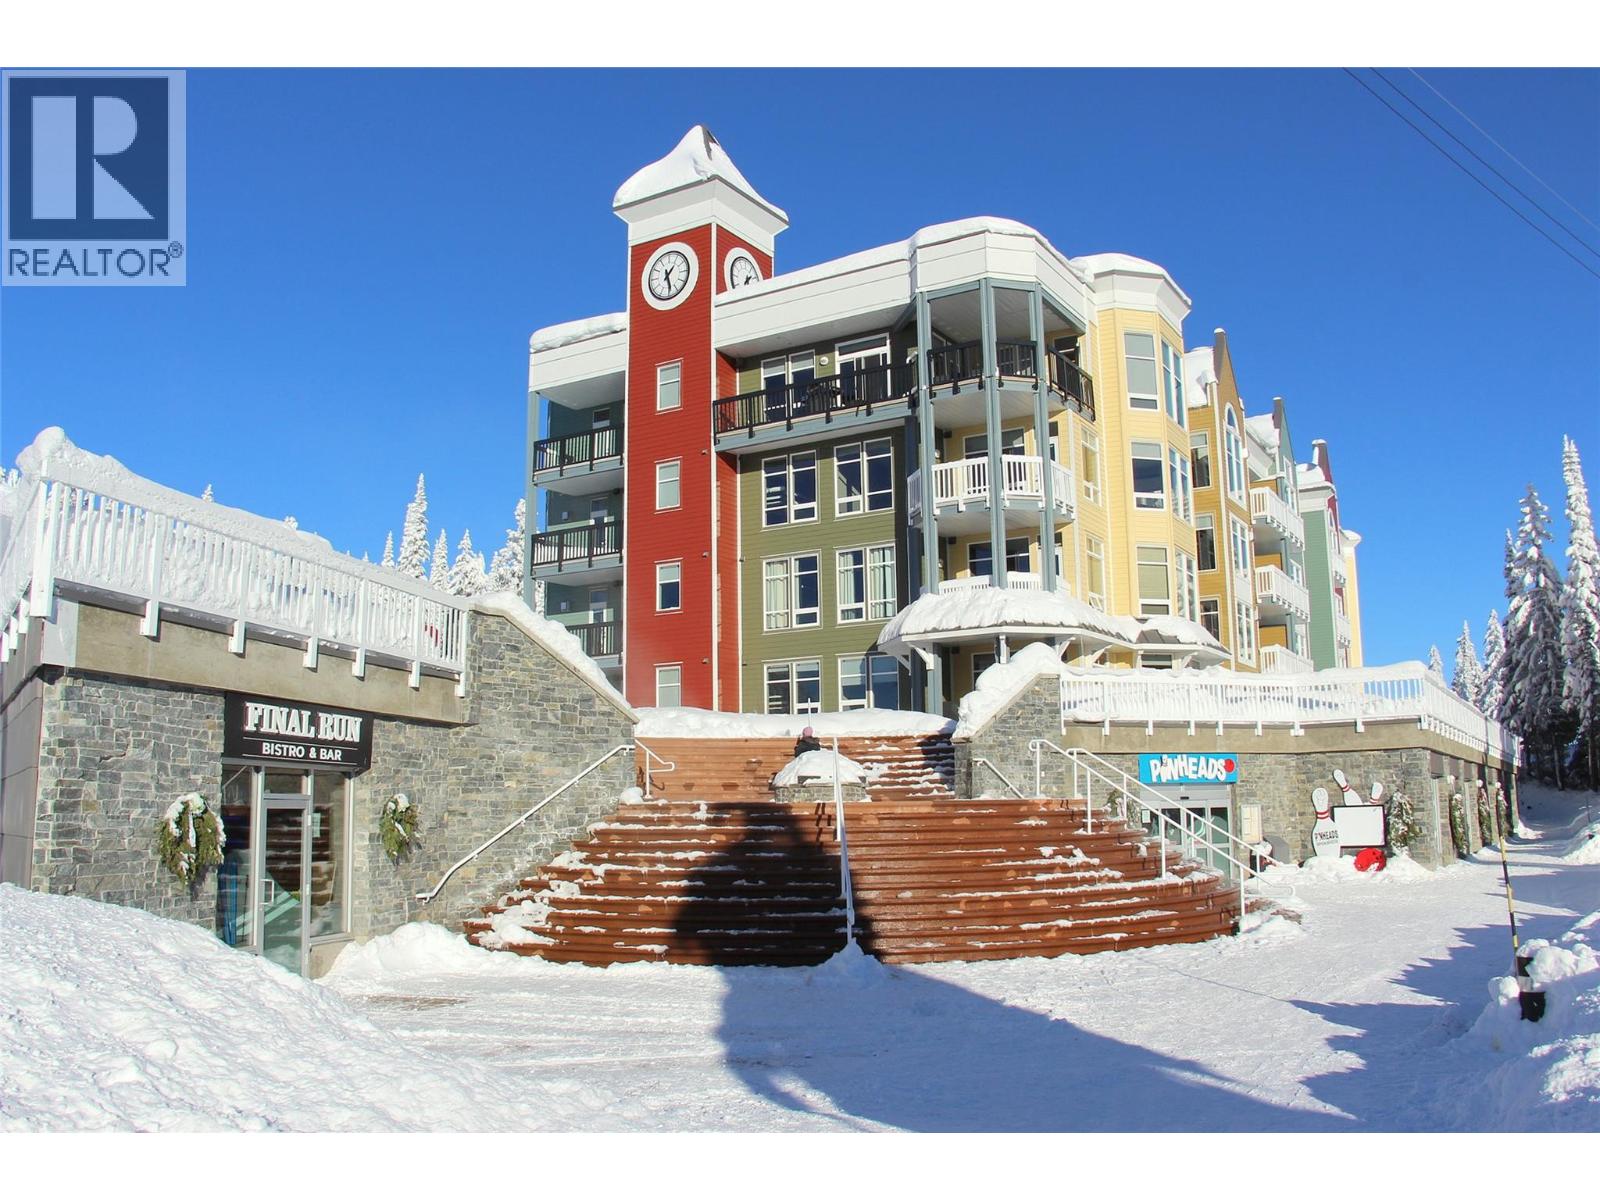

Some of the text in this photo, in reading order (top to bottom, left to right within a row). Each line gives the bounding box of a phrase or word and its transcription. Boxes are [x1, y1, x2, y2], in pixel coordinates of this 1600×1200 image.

[244, 701, 363, 743] FINAL RUN
[261, 742, 342, 761] BISTRO & BAR
[1149, 754, 1227, 783] PINHEADS
